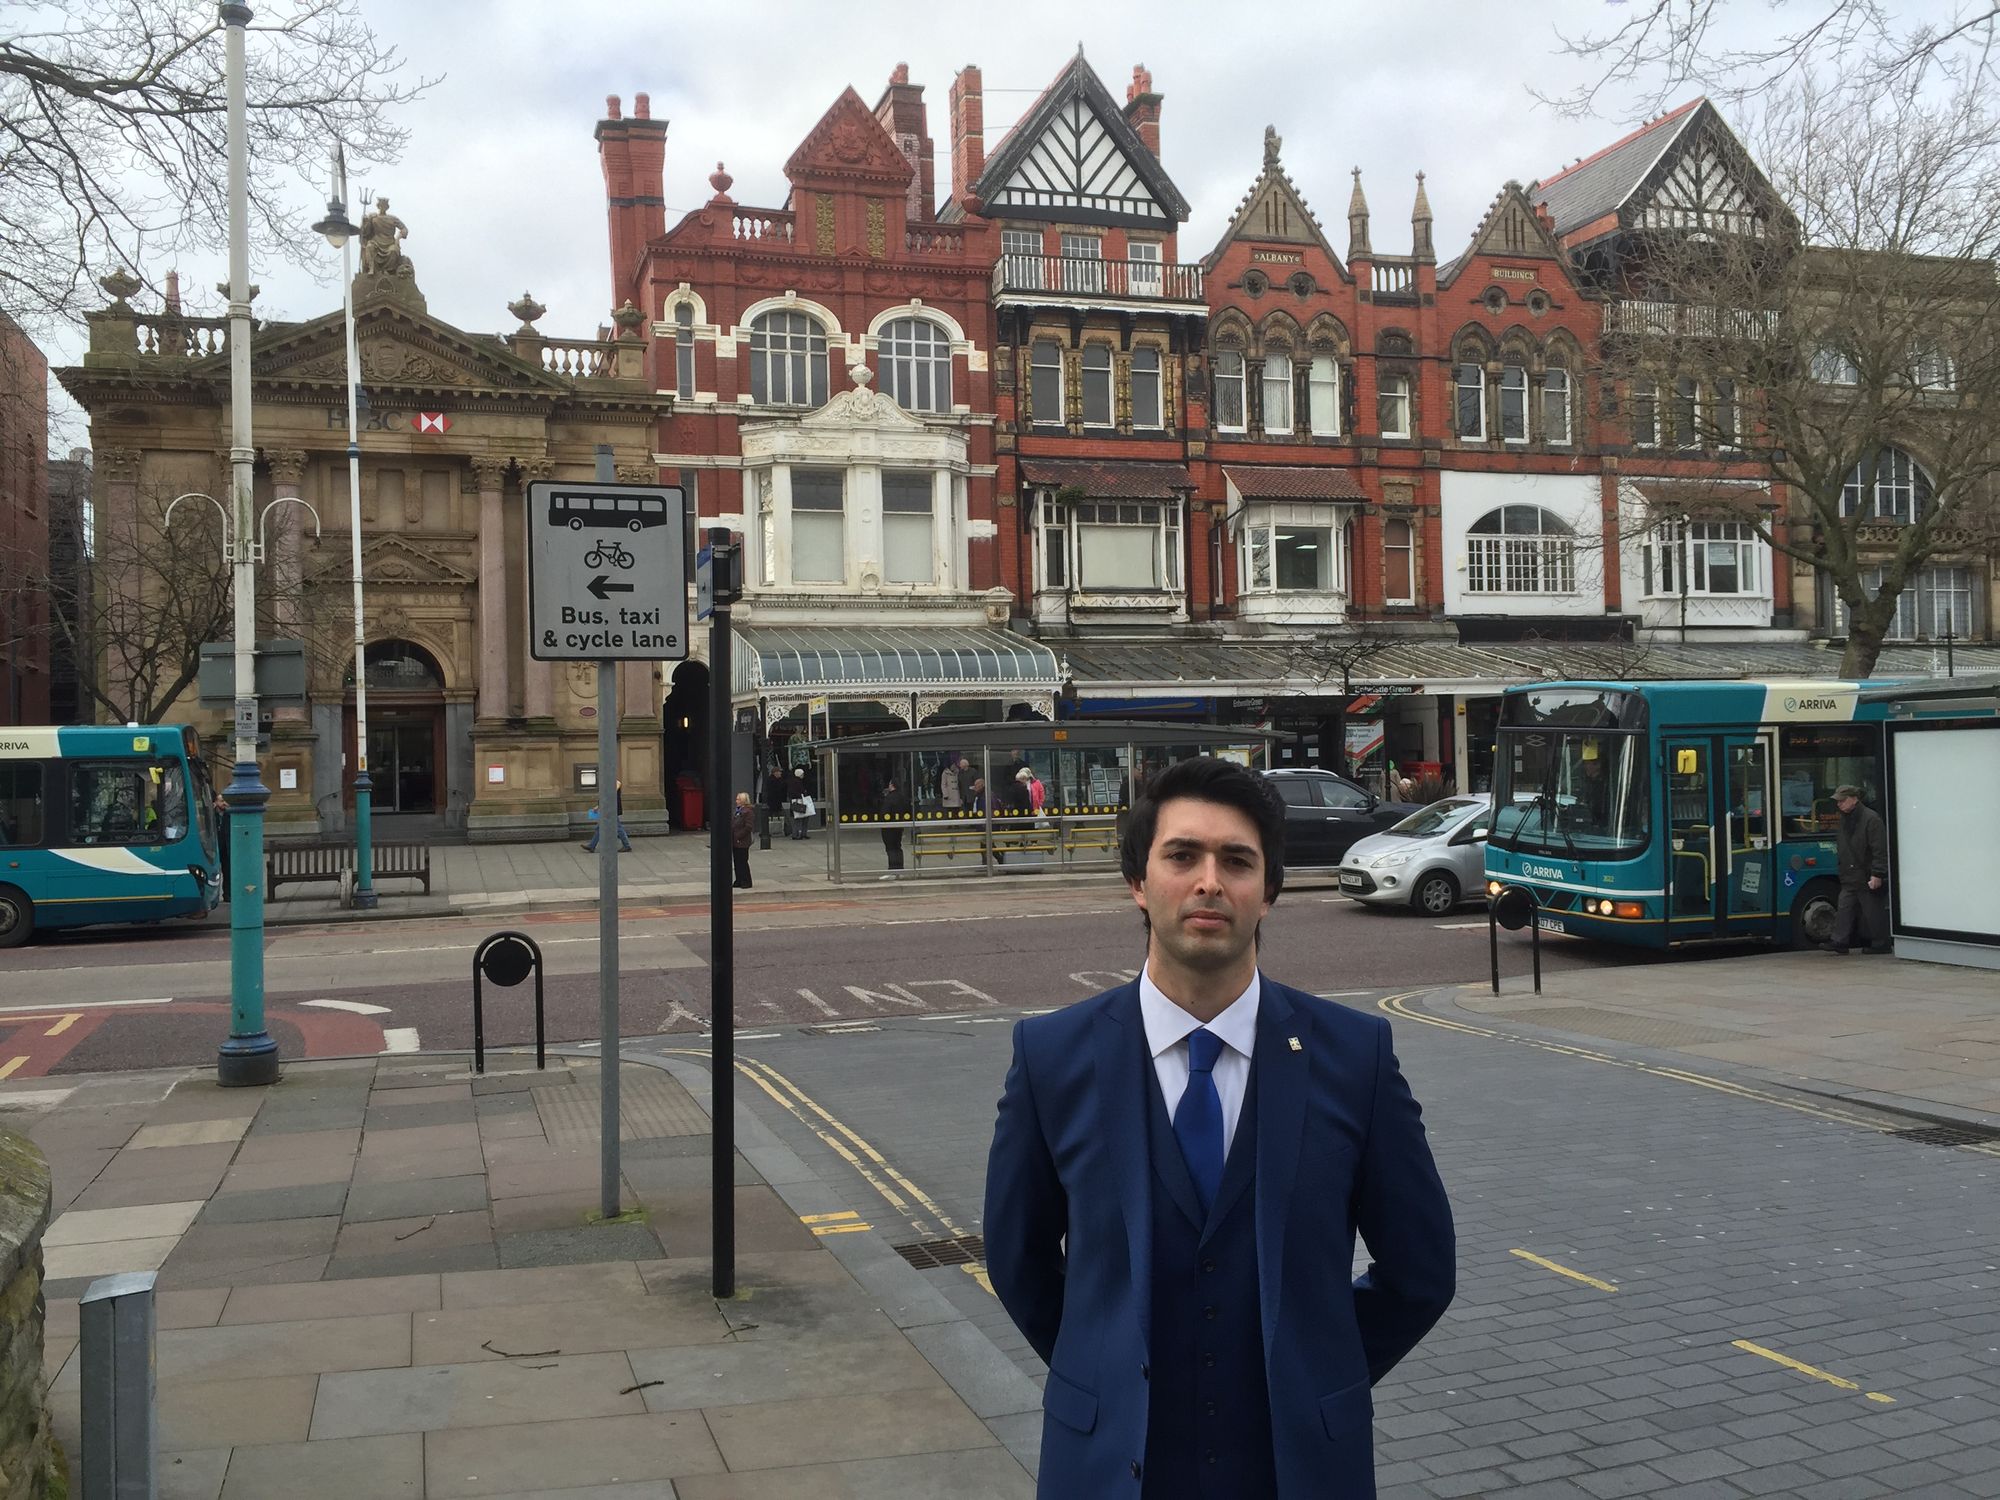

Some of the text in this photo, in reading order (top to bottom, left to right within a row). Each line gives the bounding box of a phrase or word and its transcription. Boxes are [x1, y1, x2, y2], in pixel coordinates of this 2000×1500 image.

[1259, 253, 1294, 263] ALBANY
[1493, 269, 1535, 280] BUILDINGS
[327, 408, 402, 431] HBC
[561, 606, 660, 625] Bus, taxi
[543, 629, 678, 651] & cycle lane
[1389, 685, 1412, 693] Green
[1798, 699, 1837, 710] ARRIVA
[0, 742, 29, 751] RRIVA
[1532, 865, 1564, 880] ARRIVA
